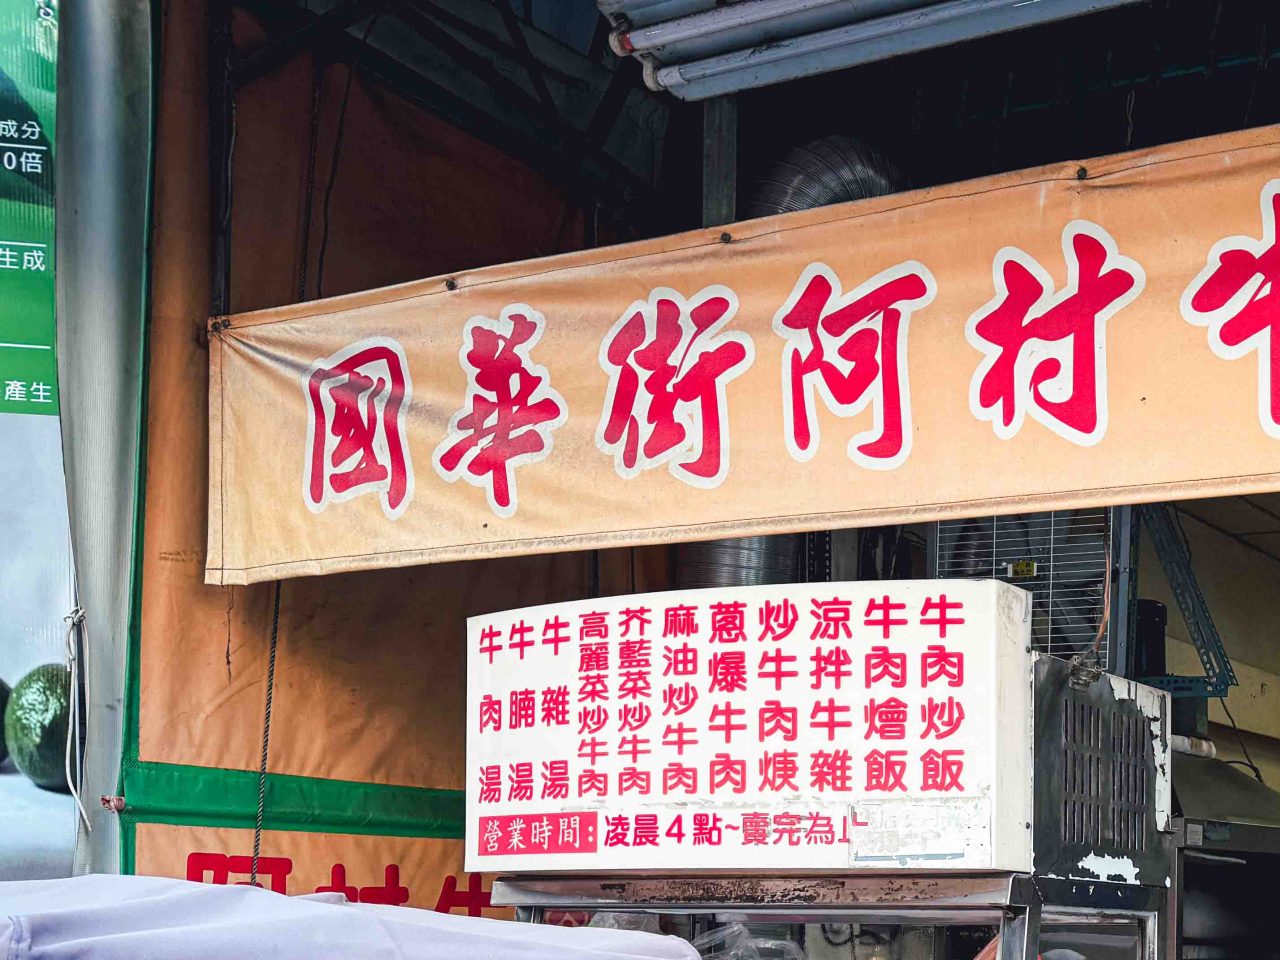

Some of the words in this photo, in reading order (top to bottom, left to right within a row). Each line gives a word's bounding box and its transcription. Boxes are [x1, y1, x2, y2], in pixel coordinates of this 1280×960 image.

[479, 625, 502, 804] 牛肉湯
[508, 619, 536, 802] 牛腩湯
[541, 615, 571, 800] 牛雜湯
[577, 611, 610, 798] 高麗菜炒牛肉
[618, 606, 652, 796] 芥藍菜炒牛肉
[662, 603, 699, 795] 麻油炒牛肉
[810, 597, 852, 792] 涼拌牛雜
[864, 595, 908, 792] 牛肉燴飯
[920, 594, 965, 792] 牛肉炒飯
